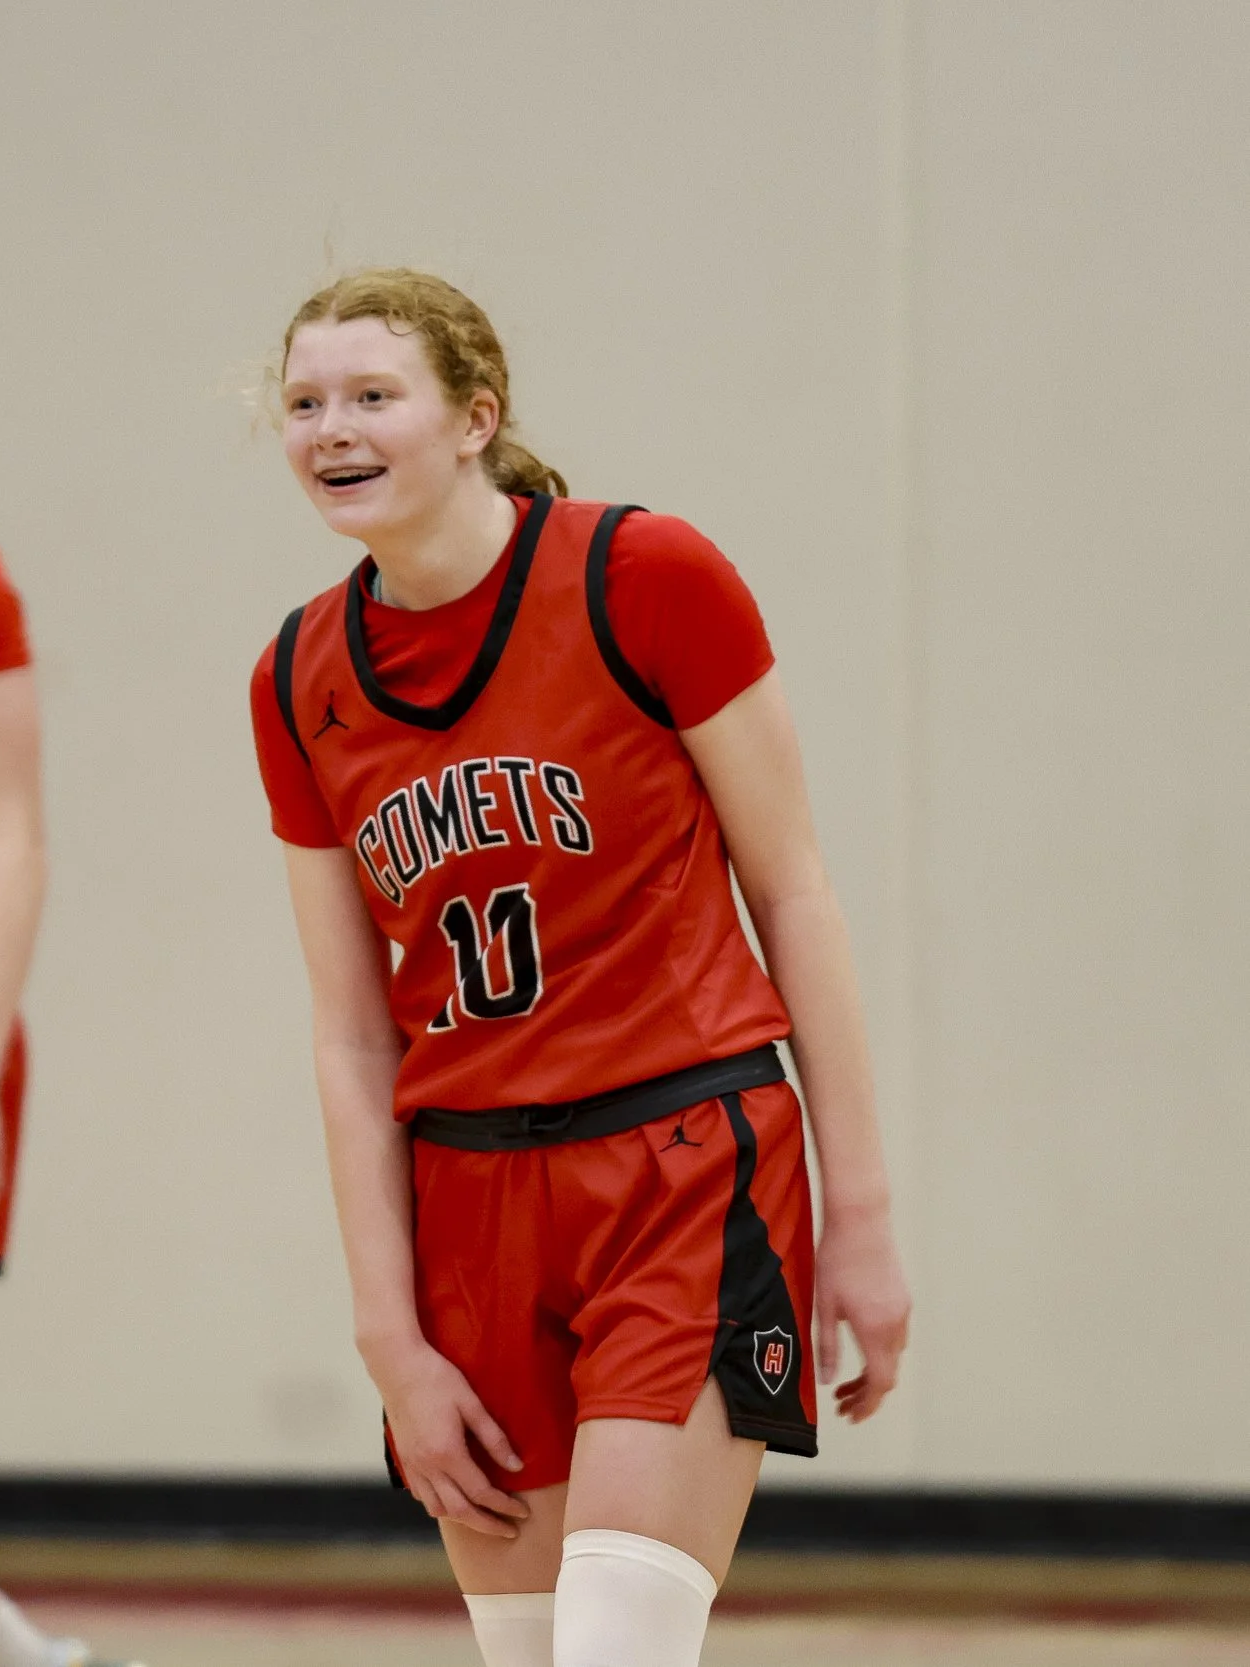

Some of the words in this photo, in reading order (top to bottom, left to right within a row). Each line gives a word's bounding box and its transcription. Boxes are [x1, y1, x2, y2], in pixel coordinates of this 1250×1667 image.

[355, 756, 594, 908] COMETS
[427, 882, 543, 1033] 10
[764, 1343, 784, 1375] H
